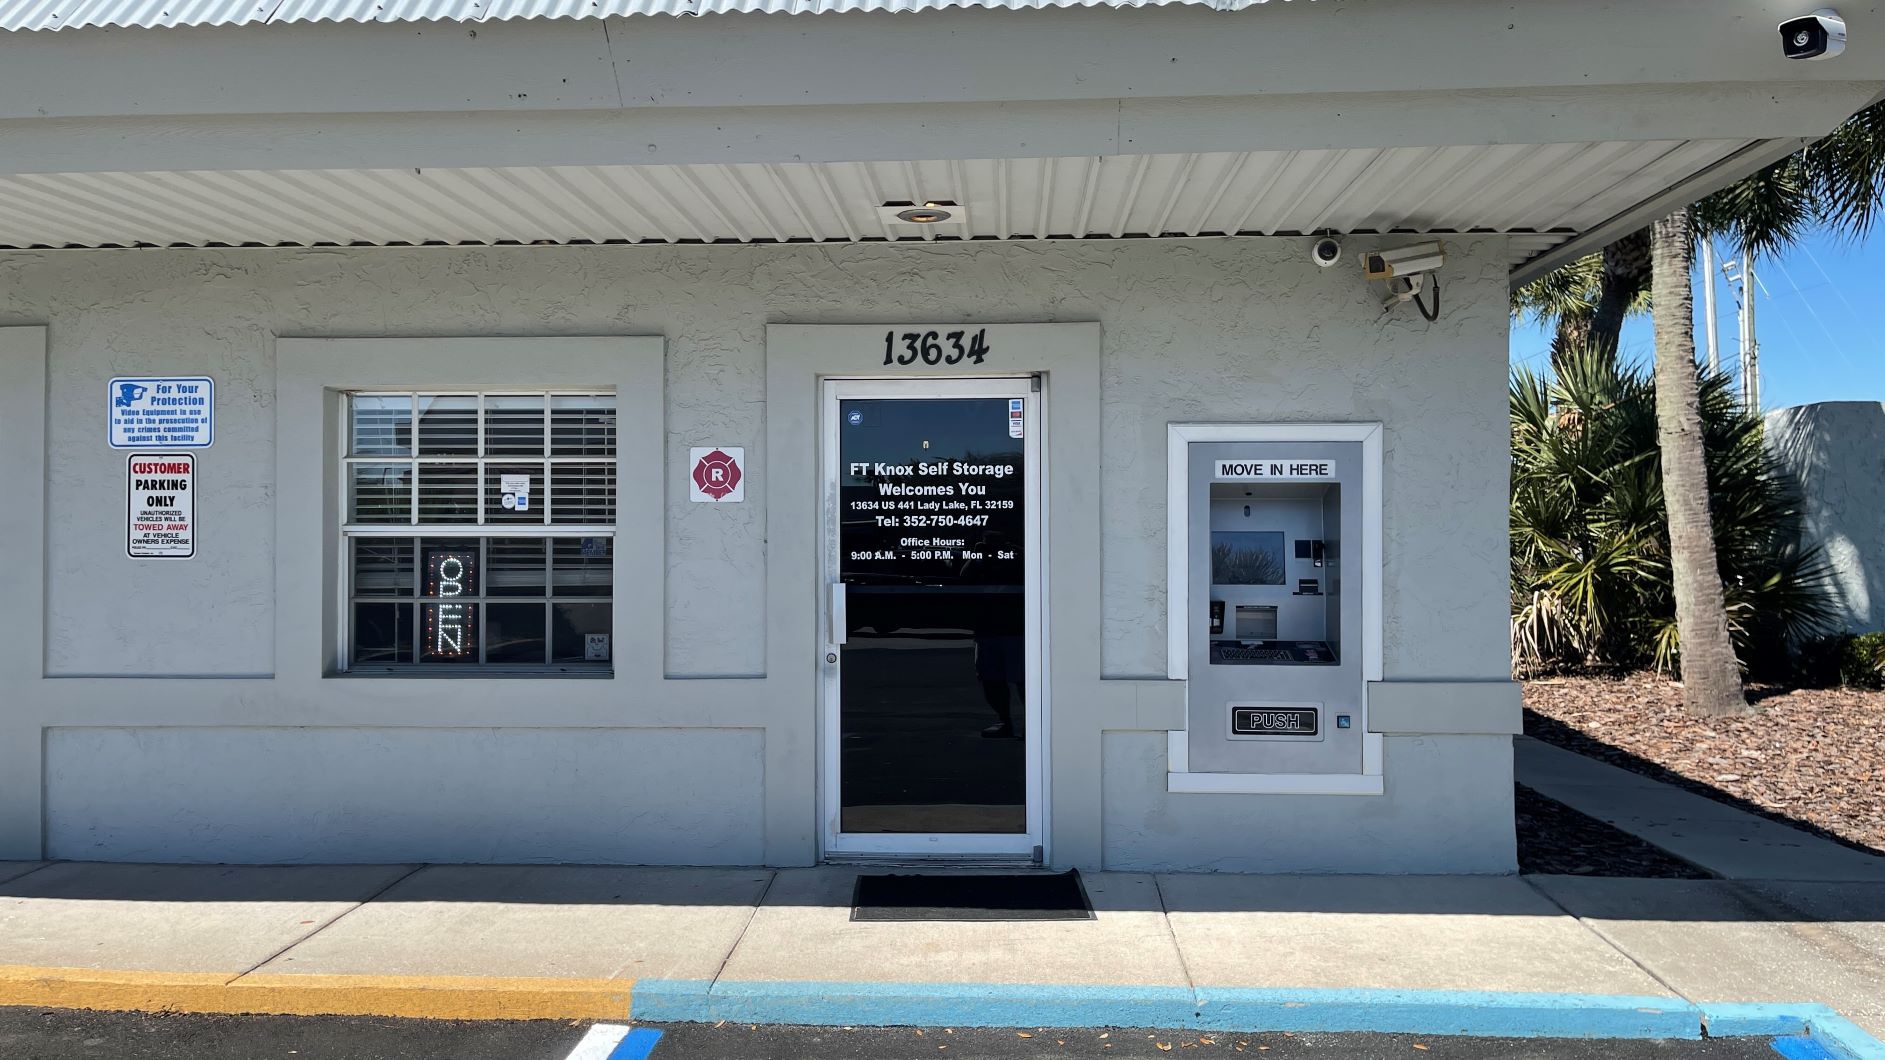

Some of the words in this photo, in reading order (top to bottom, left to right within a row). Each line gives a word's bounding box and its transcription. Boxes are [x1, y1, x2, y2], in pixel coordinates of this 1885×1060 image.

[883, 328, 990, 365] 13634
[157, 384, 172, 393] For
[177, 384, 198, 393] Your
[151, 396, 204, 406] Protection
[133, 463, 190, 474] CUSTOMER
[850, 463, 869, 475] FT
[874, 463, 913, 476] Knox
[918, 463, 948, 476] Self
[952, 463, 1013, 478] Storage
[1222, 464, 1263, 476] MOVE
[1270, 464, 1284, 475] IN
[1290, 464, 1328, 475] HERE
[712, 469, 723, 481] R
[136, 479, 187, 490] PARKING
[879, 483, 954, 496] Welcomes
[959, 483, 986, 495] You
[147, 496, 175, 507] ONLY
[918, 501, 940, 511] Lady
[943, 501, 968, 510] Lake,
[985, 501, 1013, 509] 32159
[876, 516, 899, 527] Tel:
[903, 515, 988, 527] 352-750-4647
[901, 538, 930, 546] Office
[933, 538, 964, 546] Hours:
[851, 552, 872, 560] 9:00
[875, 551, 896, 559] A.M.
[911, 551, 932, 559] 5:00
[935, 551, 953, 559] P.M.
[998, 551, 1014, 559] Sat
[438, 558, 463, 652] OPEN
[1250, 713, 1300, 729] PUSH
